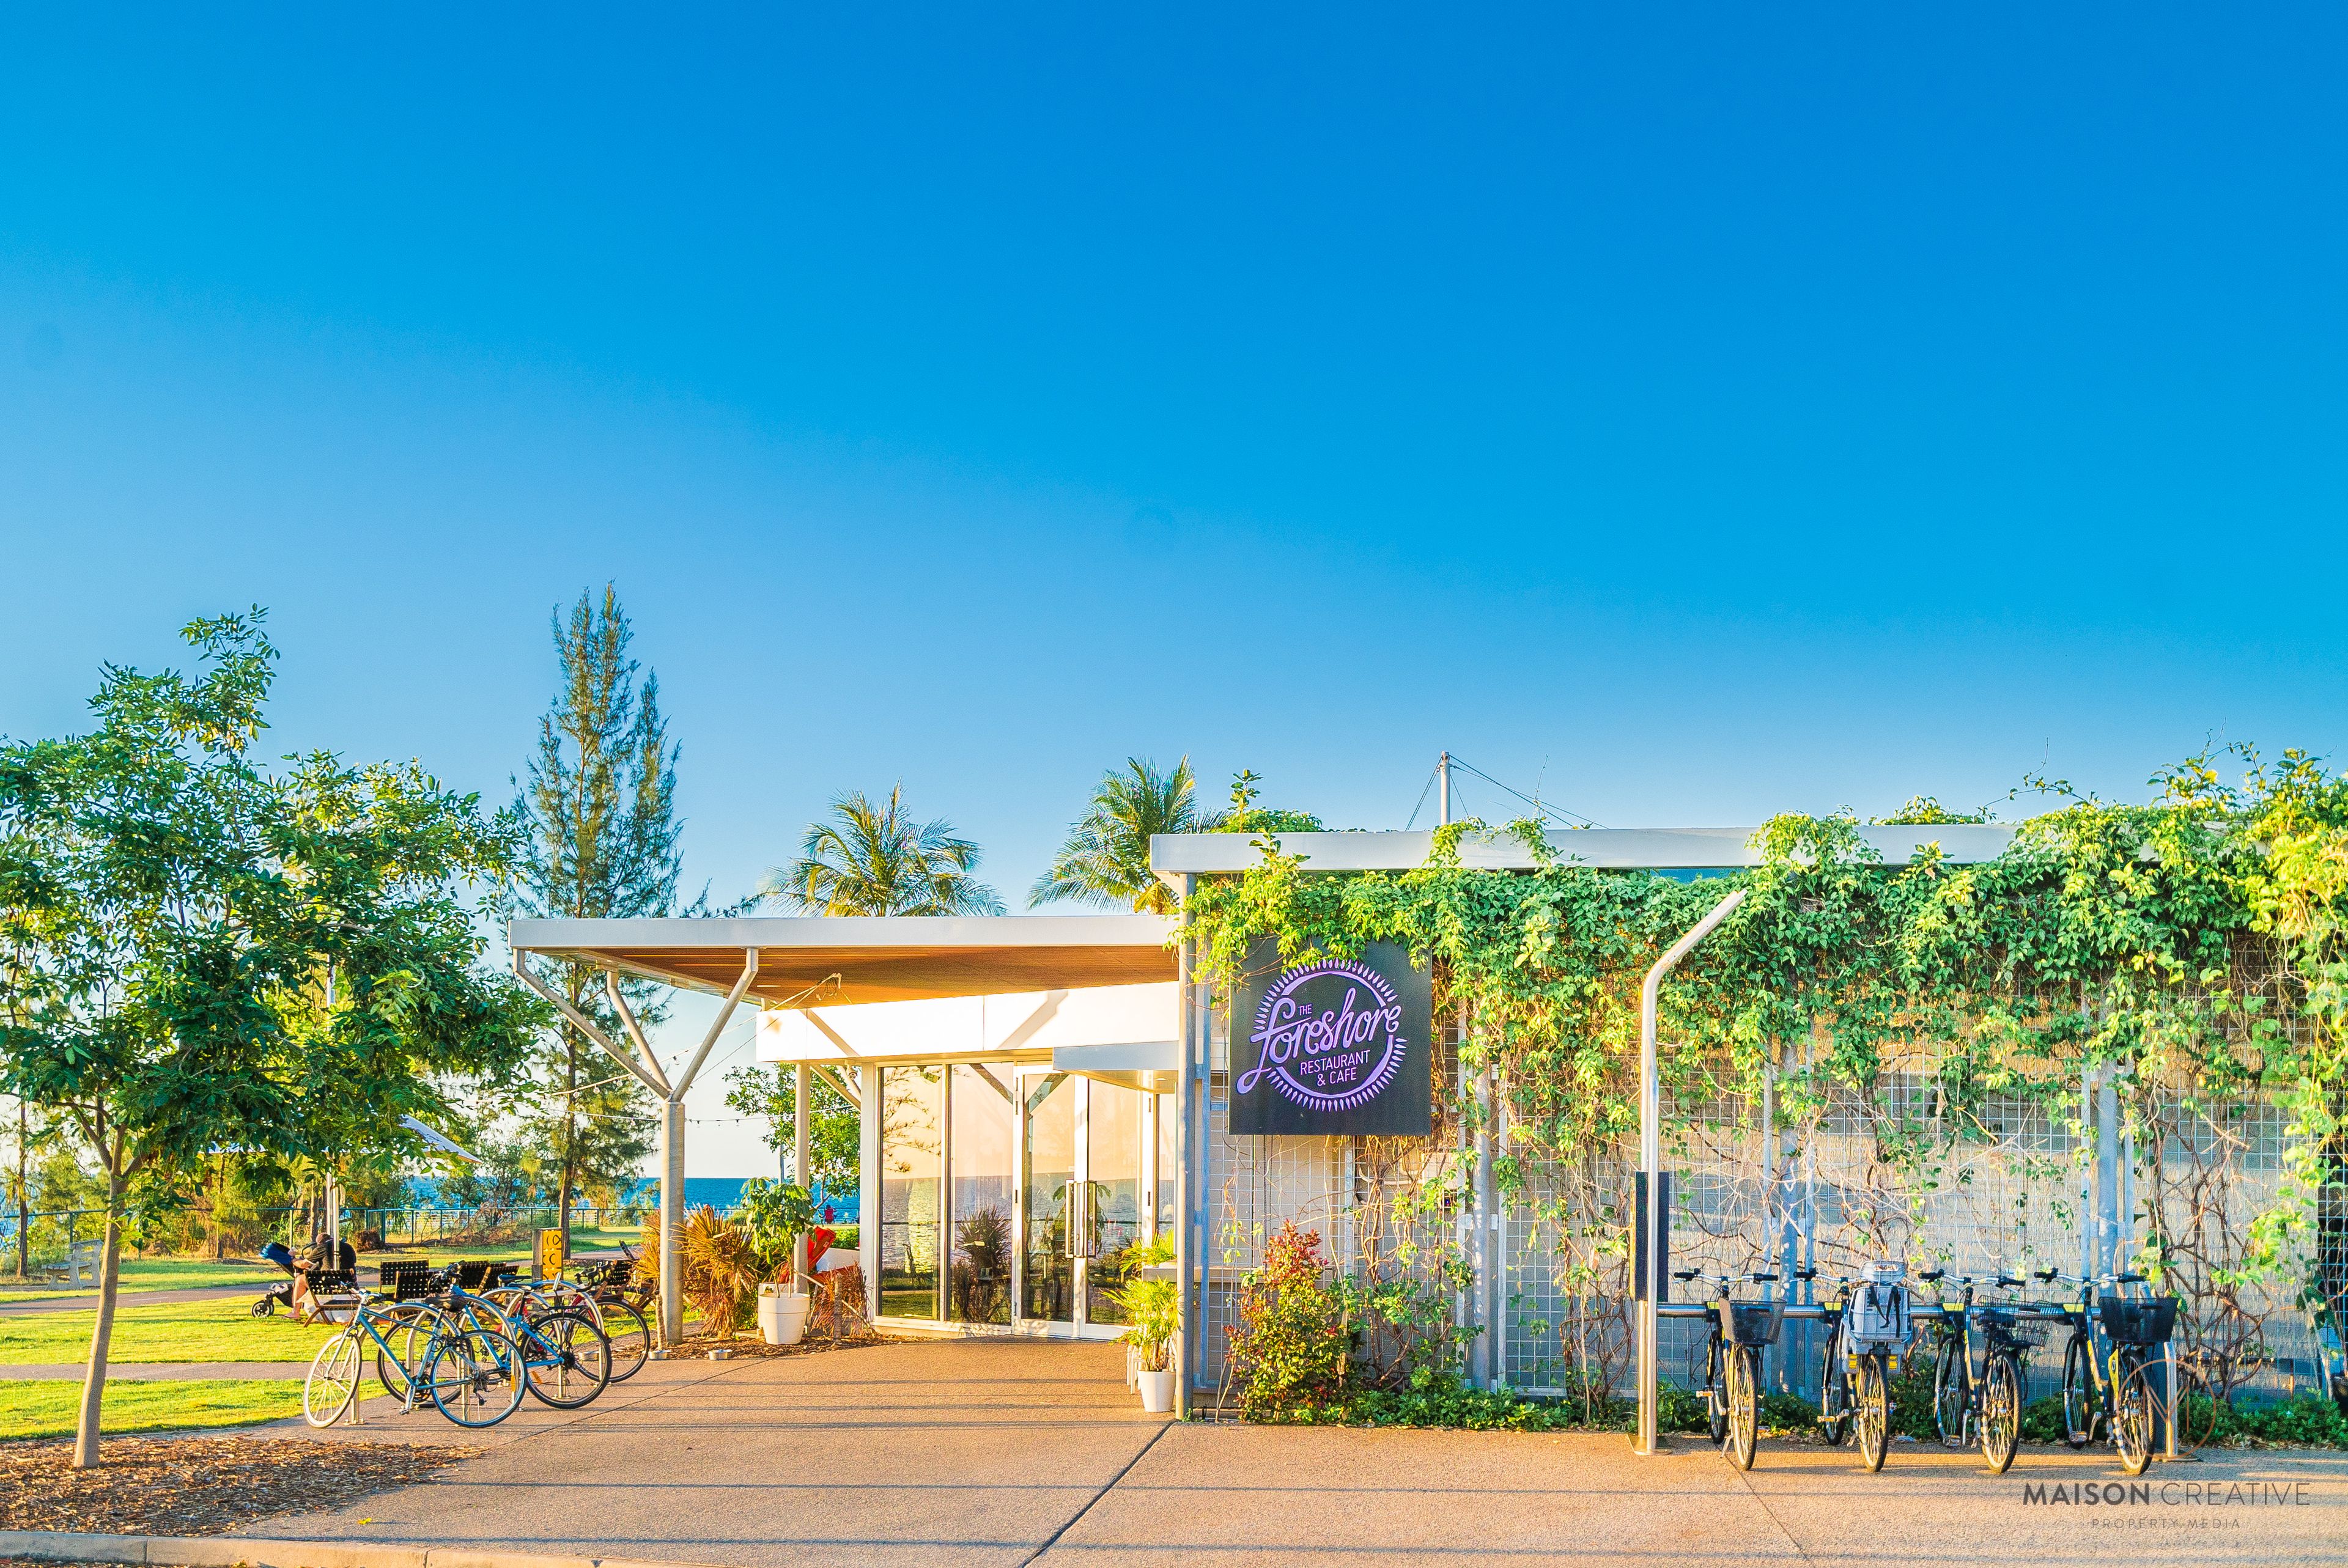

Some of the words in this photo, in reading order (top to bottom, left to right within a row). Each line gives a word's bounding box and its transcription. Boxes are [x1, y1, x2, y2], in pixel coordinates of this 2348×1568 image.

[1298, 1004, 1312, 1015] THE
[1300, 1050, 1371, 1075] RESTAURANT
[1317, 1074, 1326, 1086] &
[1329, 1067, 1357, 1083] CAFE
